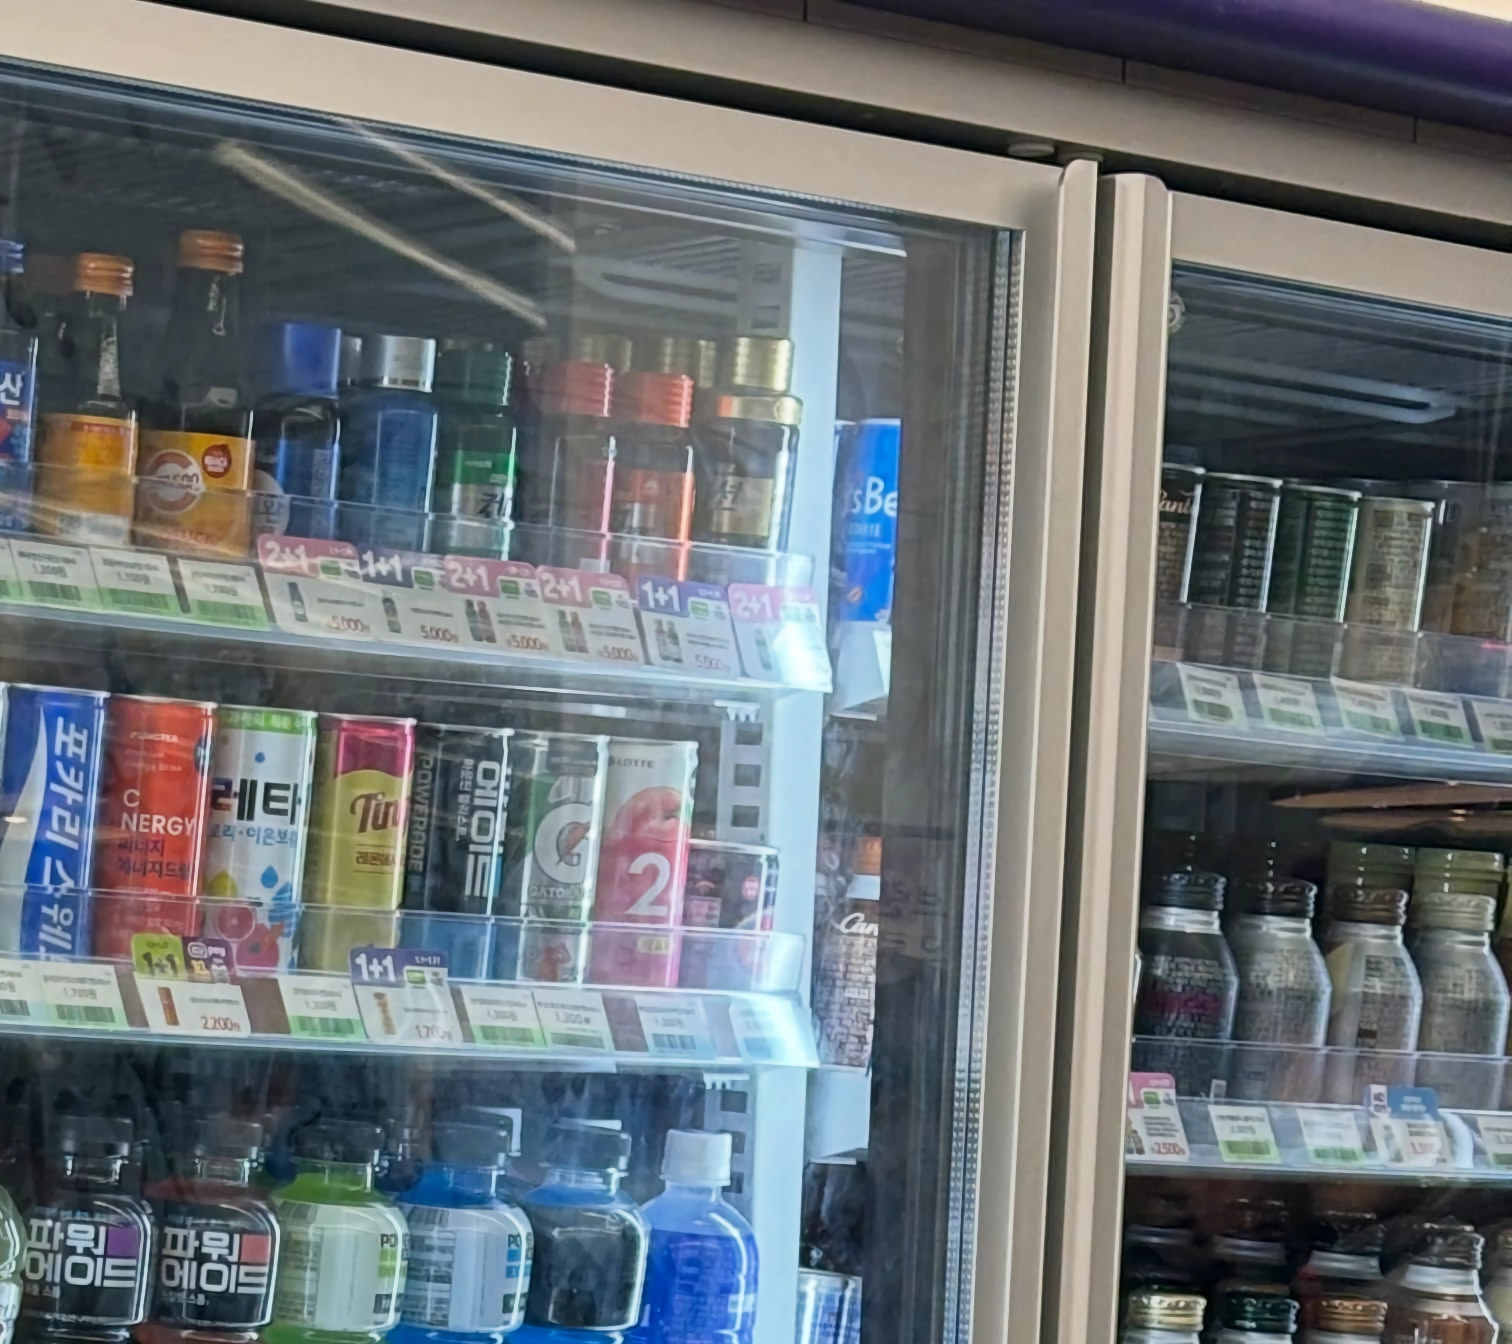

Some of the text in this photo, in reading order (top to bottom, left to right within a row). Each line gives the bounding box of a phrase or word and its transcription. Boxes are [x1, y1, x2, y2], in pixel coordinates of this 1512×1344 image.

[362, 549, 404, 583] 1+1
[448, 562, 490, 593] 2+1
[541, 572, 583, 603] 2+1
[641, 580, 681, 613] 1+1
[45, 716, 89, 851] 포카리
[123, 788, 141, 808] C
[121, 812, 197, 837] NERGY
[355, 952, 397, 984] 1+1
[26, 1217, 106, 1256] 파워
[161, 1225, 241, 1262] 파워
[25, 1250, 138, 1289] 에이드
[160, 1257, 269, 1295] 에이드
